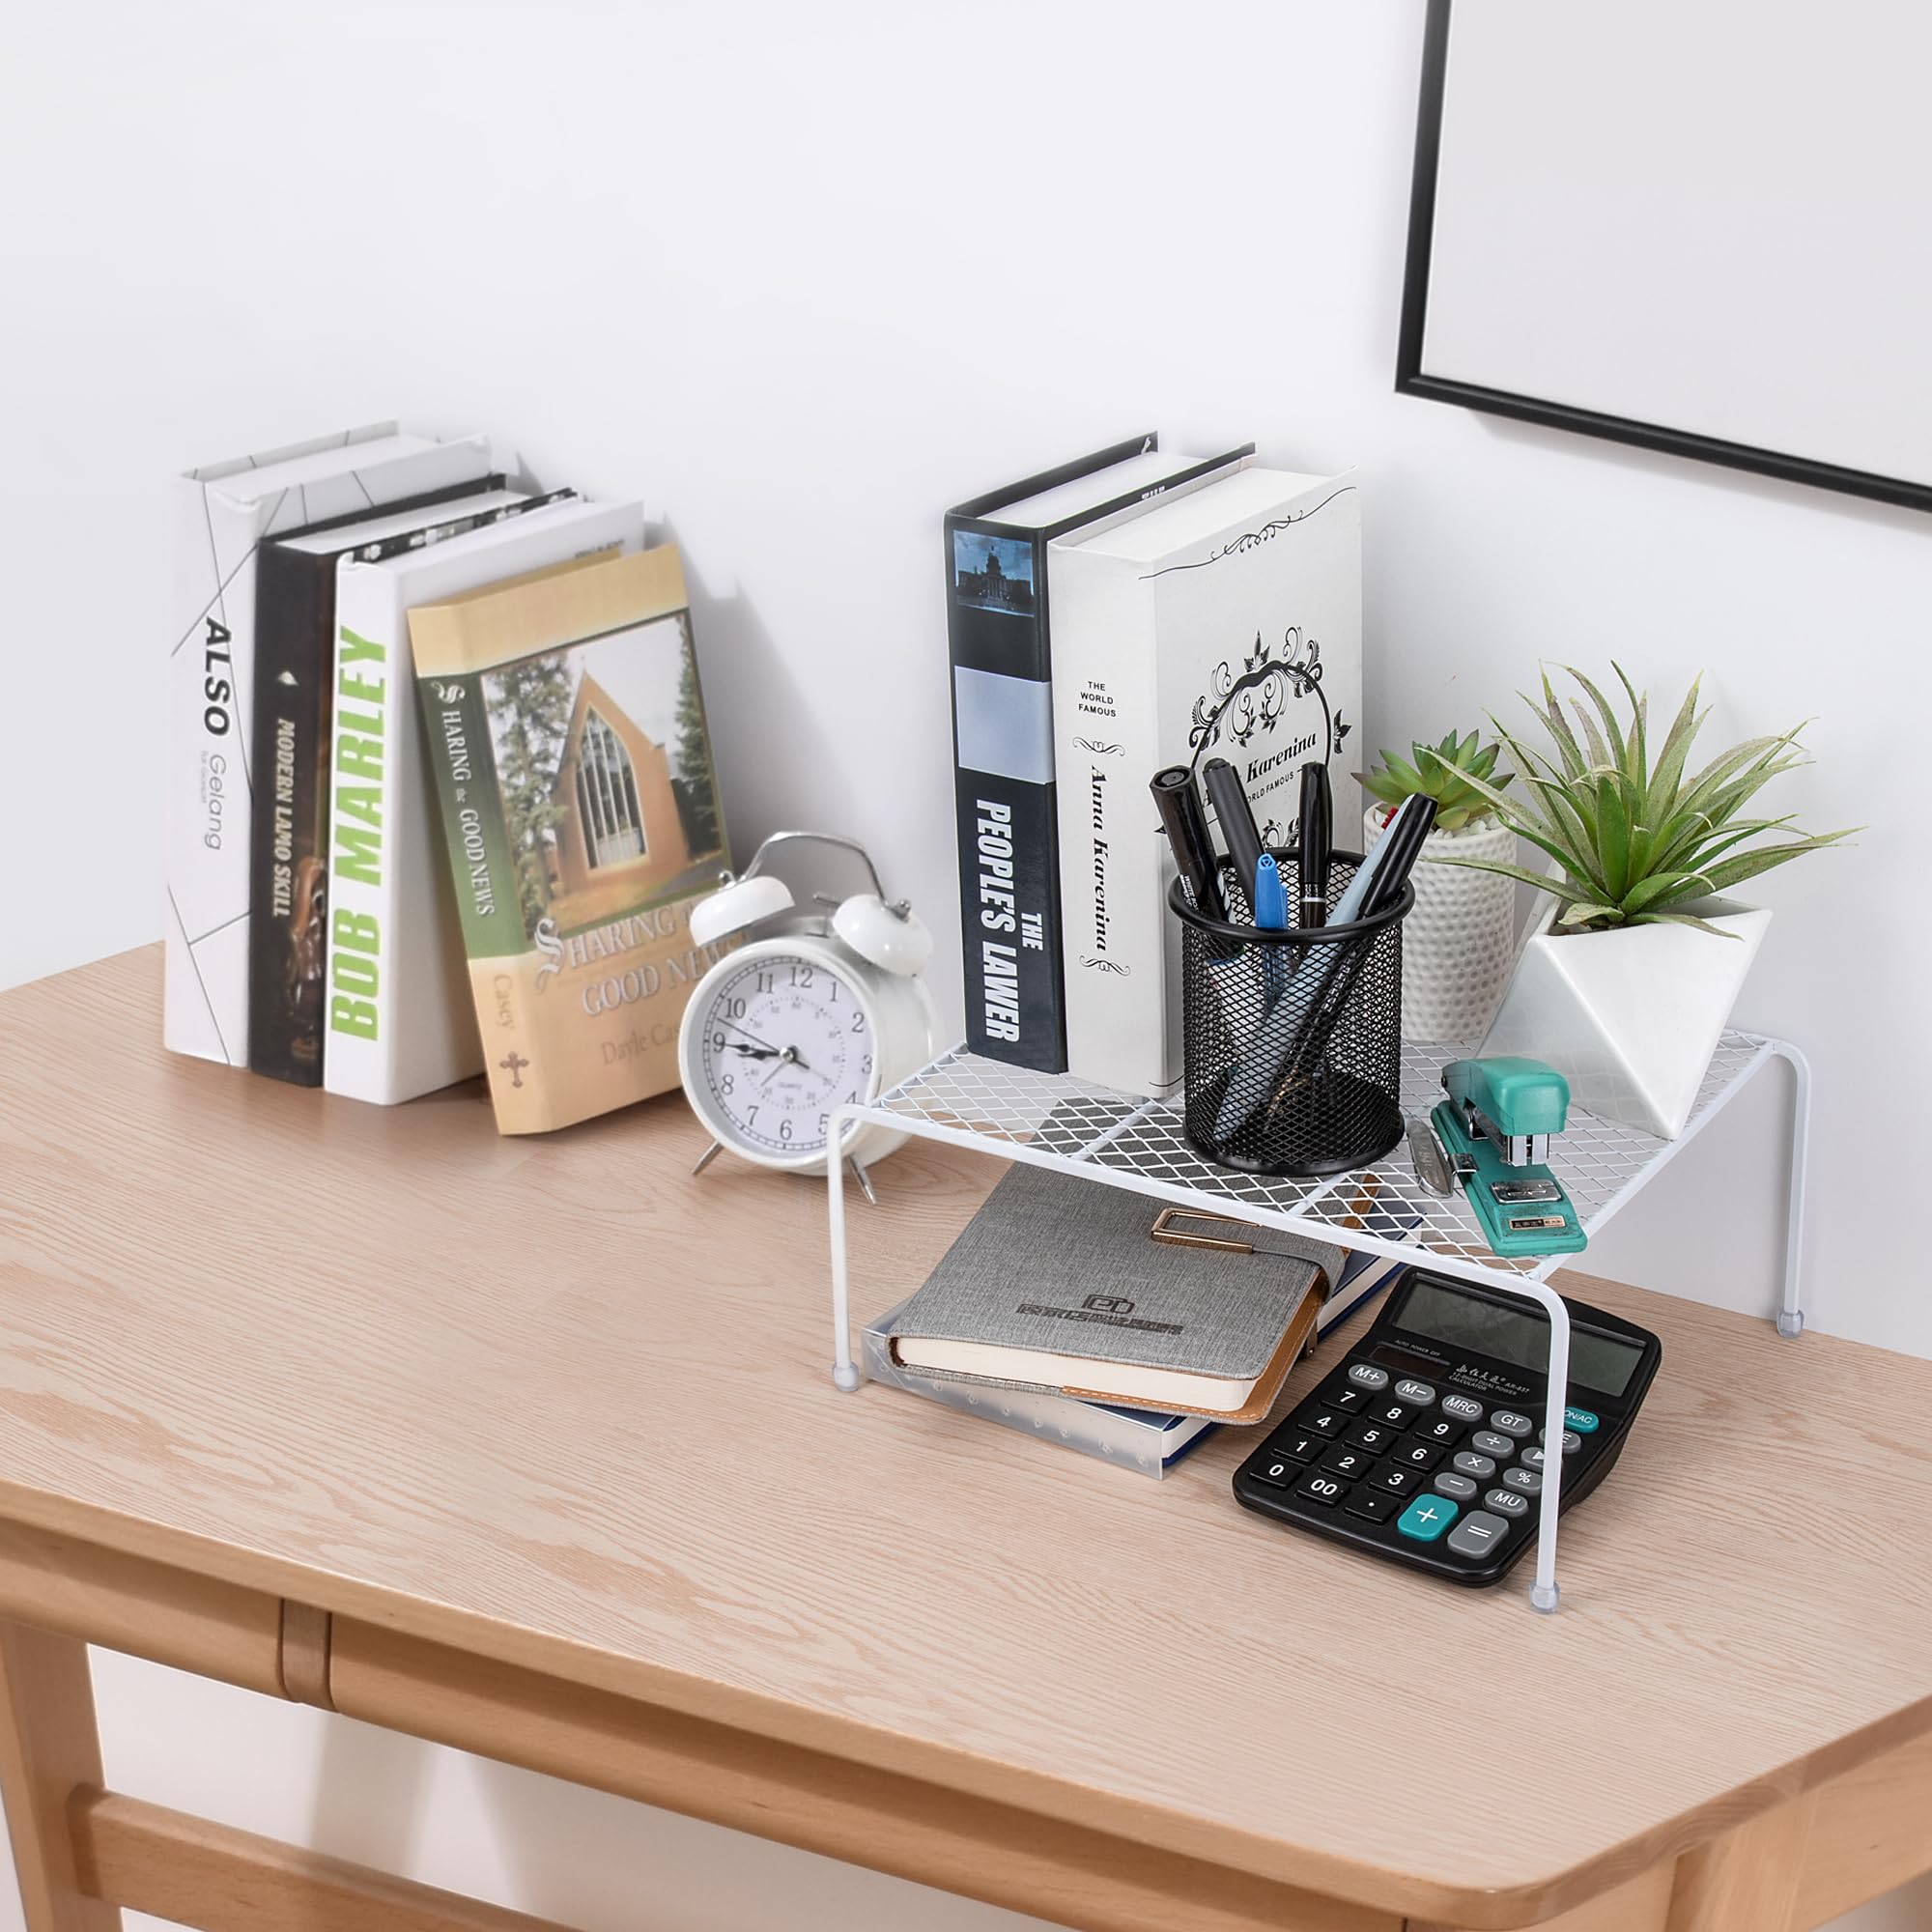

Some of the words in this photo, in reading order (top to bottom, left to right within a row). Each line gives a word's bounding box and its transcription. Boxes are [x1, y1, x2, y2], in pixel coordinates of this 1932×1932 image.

[203, 616, 232, 737] ALSO
[1088, 680, 1107, 693] THE
[1080, 693, 1115, 706] WORLD
[1078, 703, 1118, 719] FAMOUS
[276, 718, 296, 803] MODERN
[334, 625, 386, 887] MARLEY
[1245, 732, 1318, 784] Karenina
[1091, 764, 1109, 832] Anna
[1247, 787, 1265, 804] ORLD
[1265, 773, 1295, 794] FAMOUS
[205, 753, 228, 851] Gelang
[274, 806, 294, 861] LAMO
[459, 808, 485, 863] GOOD
[976, 799, 1016, 934] PEOPLE'S
[272, 864, 292, 918] SKILL
[469, 863, 496, 917] NEWS
[1092, 837, 1111, 952] Karenina
[1020, 911, 1044, 952] THE
[331, 908, 382, 1042] BOB
[756, 972, 774, 994] 11
[789, 967, 813, 988] 12
[582, 964, 662, 1017] GOOD
[830, 981, 838, 1003] 1
[982, 939, 1021, 1044] LAWER
[725, 998, 747, 1020] 10
[851, 1011, 866, 1034] 2
[713, 1032, 725, 1053] 9
[721, 1074, 735, 1095] 8
[746, 1105, 760, 1125] 7
[780, 1120, 793, 1141] 6
[1354, 1366, 1380, 1381] M+
[1339, 1391, 1356, 1404] 7
[1445, 1397, 1478, 1415] MRC
[1316, 1416, 1332, 1428] 4
[1385, 1407, 1402, 1420] 8
[1500, 1413, 1524, 1429] GT
[1363, 1430, 1380, 1443] 5
[1433, 1423, 1449, 1436] 9
[1295, 1440, 1308, 1453] 1
[1411, 1448, 1428, 1461] 6
[1268, 1463, 1285, 1477] 0
[1338, 1456, 1355, 1469] 2
[1310, 1479, 1338, 1496] 00
[1388, 1473, 1405, 1486] 3
[1493, 1492, 1521, 1508] MU
